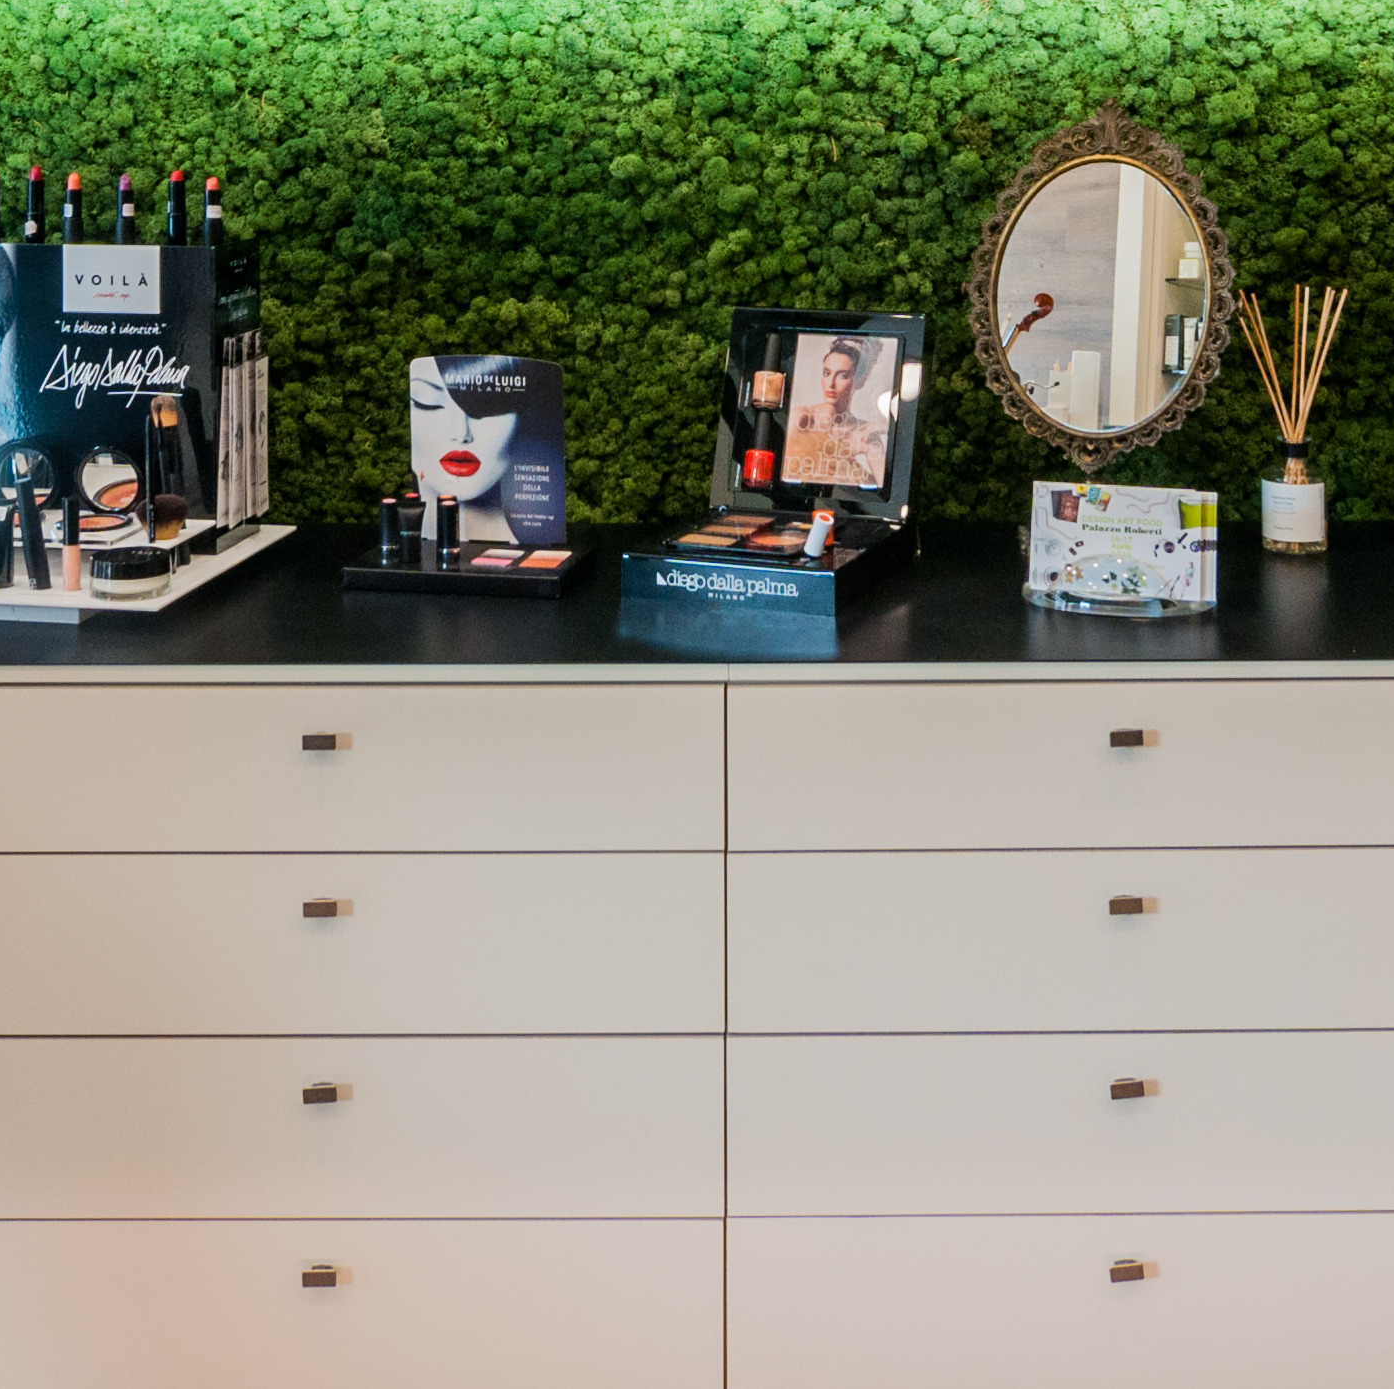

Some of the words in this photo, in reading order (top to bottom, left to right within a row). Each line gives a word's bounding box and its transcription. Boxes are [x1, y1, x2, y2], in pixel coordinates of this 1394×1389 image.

[73, 319, 108, 335] bellezza
[445, 373, 481, 386] MARIO
[495, 375, 526, 387] LUIGI
[459, 384, 511, 393] MILANO
[522, 483, 542, 492] DELLA
[514, 493, 550, 502] PERFEZIONE
[1082, 514, 1115, 525] DESIGN
[1116, 516, 1135, 525] ART
[1136, 517, 1163, 527] FOOD
[1082, 523, 1122, 533] Palazzo
[667, 568, 706, 592] diego
[707, 573, 746, 593] dalla
[746, 577, 799, 598] palma
[708, 592, 745, 601] MILANO
